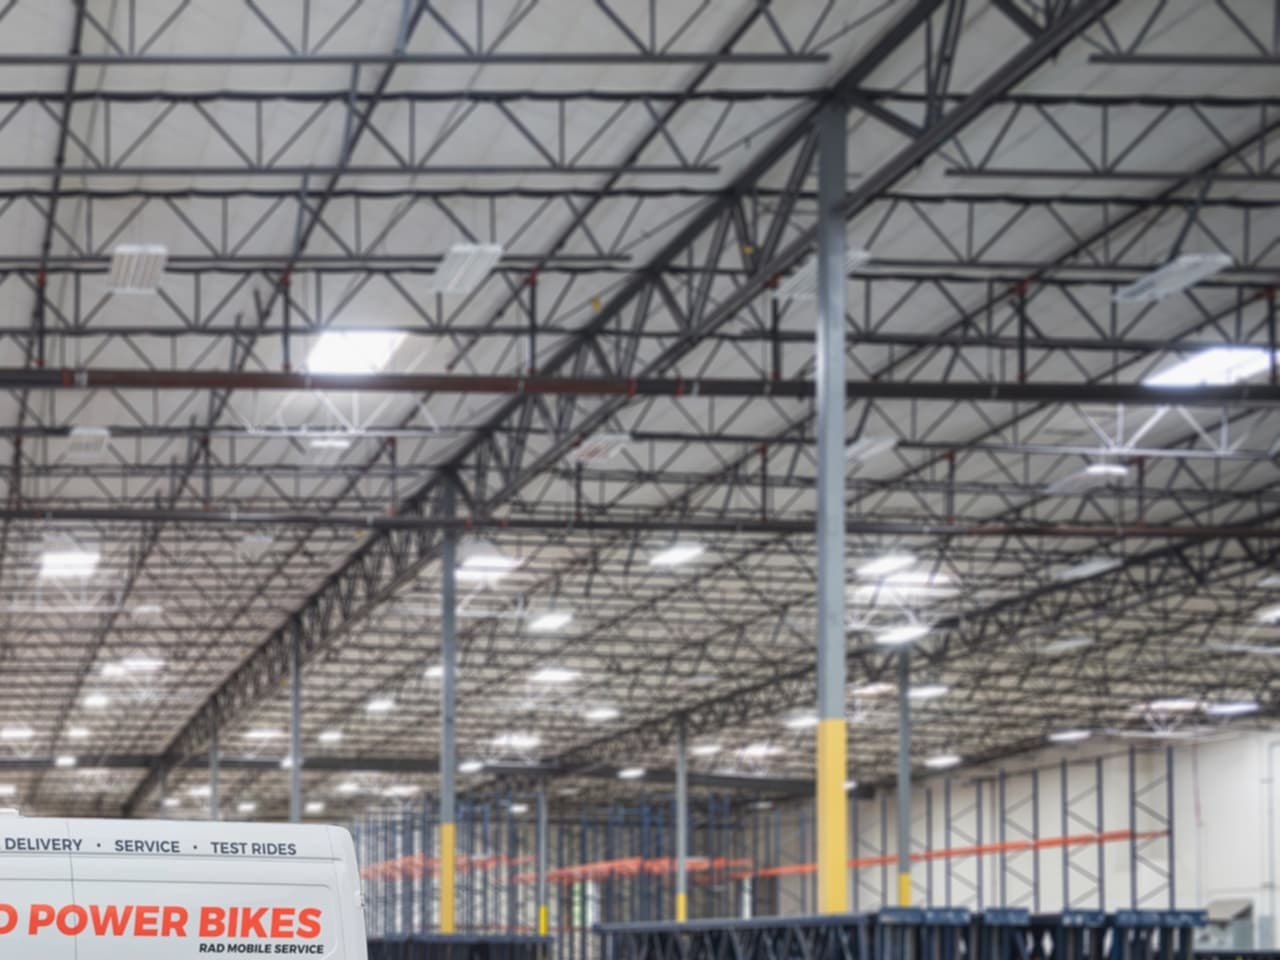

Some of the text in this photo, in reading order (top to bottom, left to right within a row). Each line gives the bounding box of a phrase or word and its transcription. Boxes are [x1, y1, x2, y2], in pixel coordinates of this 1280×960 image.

[5, 838, 82, 851] DELIVERY
[115, 839, 180, 853] SERVICE
[210, 841, 247, 854] TEST
[252, 842, 297, 855] RIDES
[28, 904, 189, 937] POWER
[199, 906, 322, 939] BIKES
[199, 943, 324, 955] RAD MOBILE SERVICE
